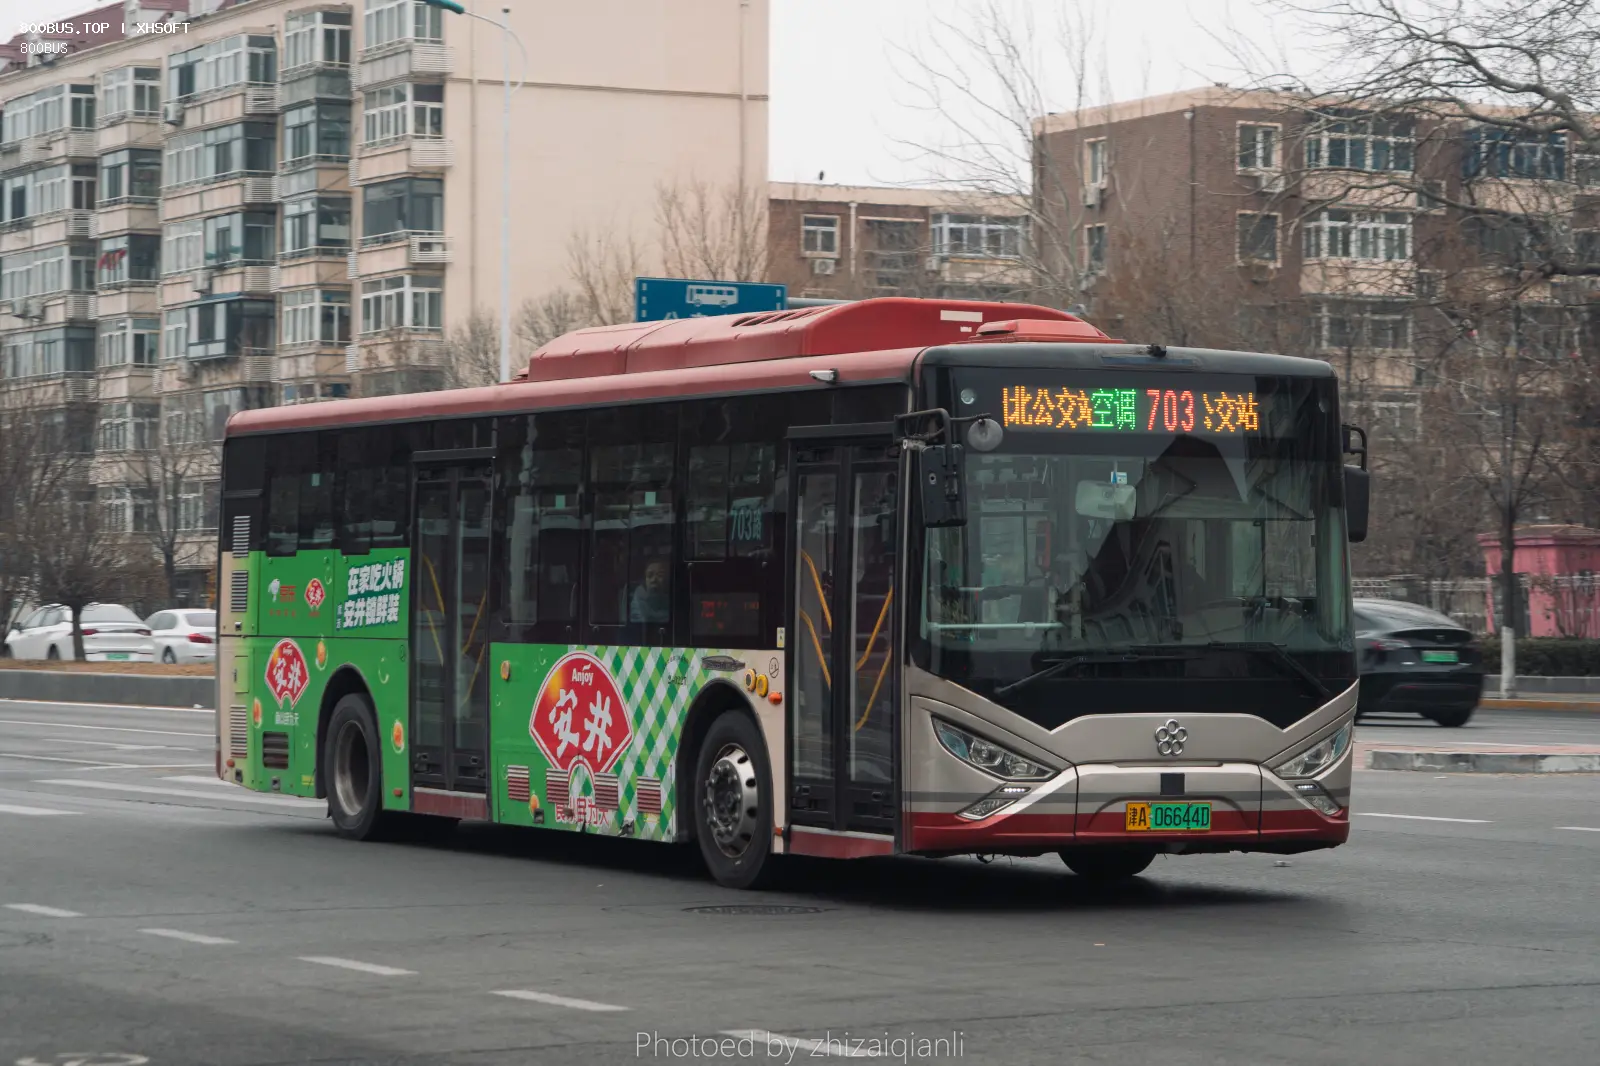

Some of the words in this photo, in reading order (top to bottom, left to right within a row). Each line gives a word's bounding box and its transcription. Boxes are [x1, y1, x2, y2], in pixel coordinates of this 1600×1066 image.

[1146, 389, 1195, 432] 703
[348, 560, 404, 595] 在家吃火锅
[572, 667, 594, 685] Anjoy
[549, 687, 614, 763] 安井
